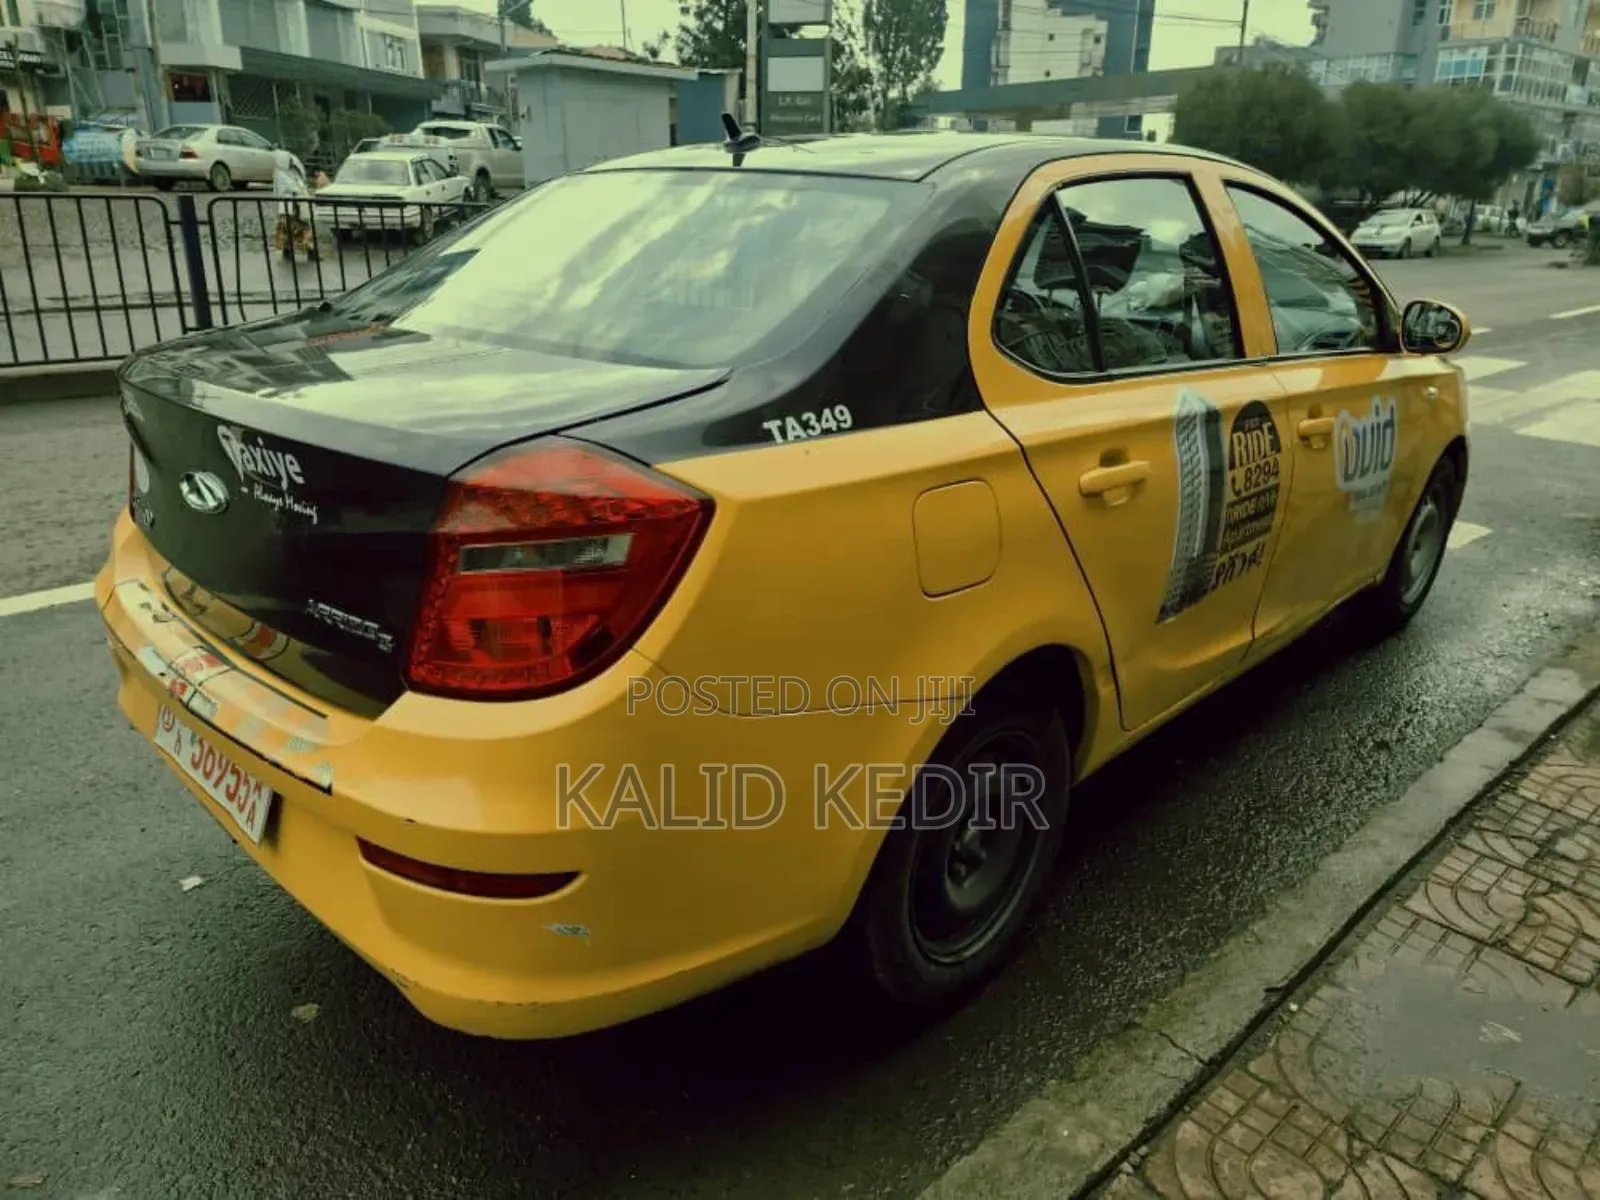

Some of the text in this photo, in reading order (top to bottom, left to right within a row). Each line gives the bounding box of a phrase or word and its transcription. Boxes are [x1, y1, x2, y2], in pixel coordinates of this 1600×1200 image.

[762, 404, 853, 444] TA349
[1232, 421, 1276, 470] RIDE
[217, 425, 305, 491] Taxiye
[1243, 451, 1280, 489] 8294
